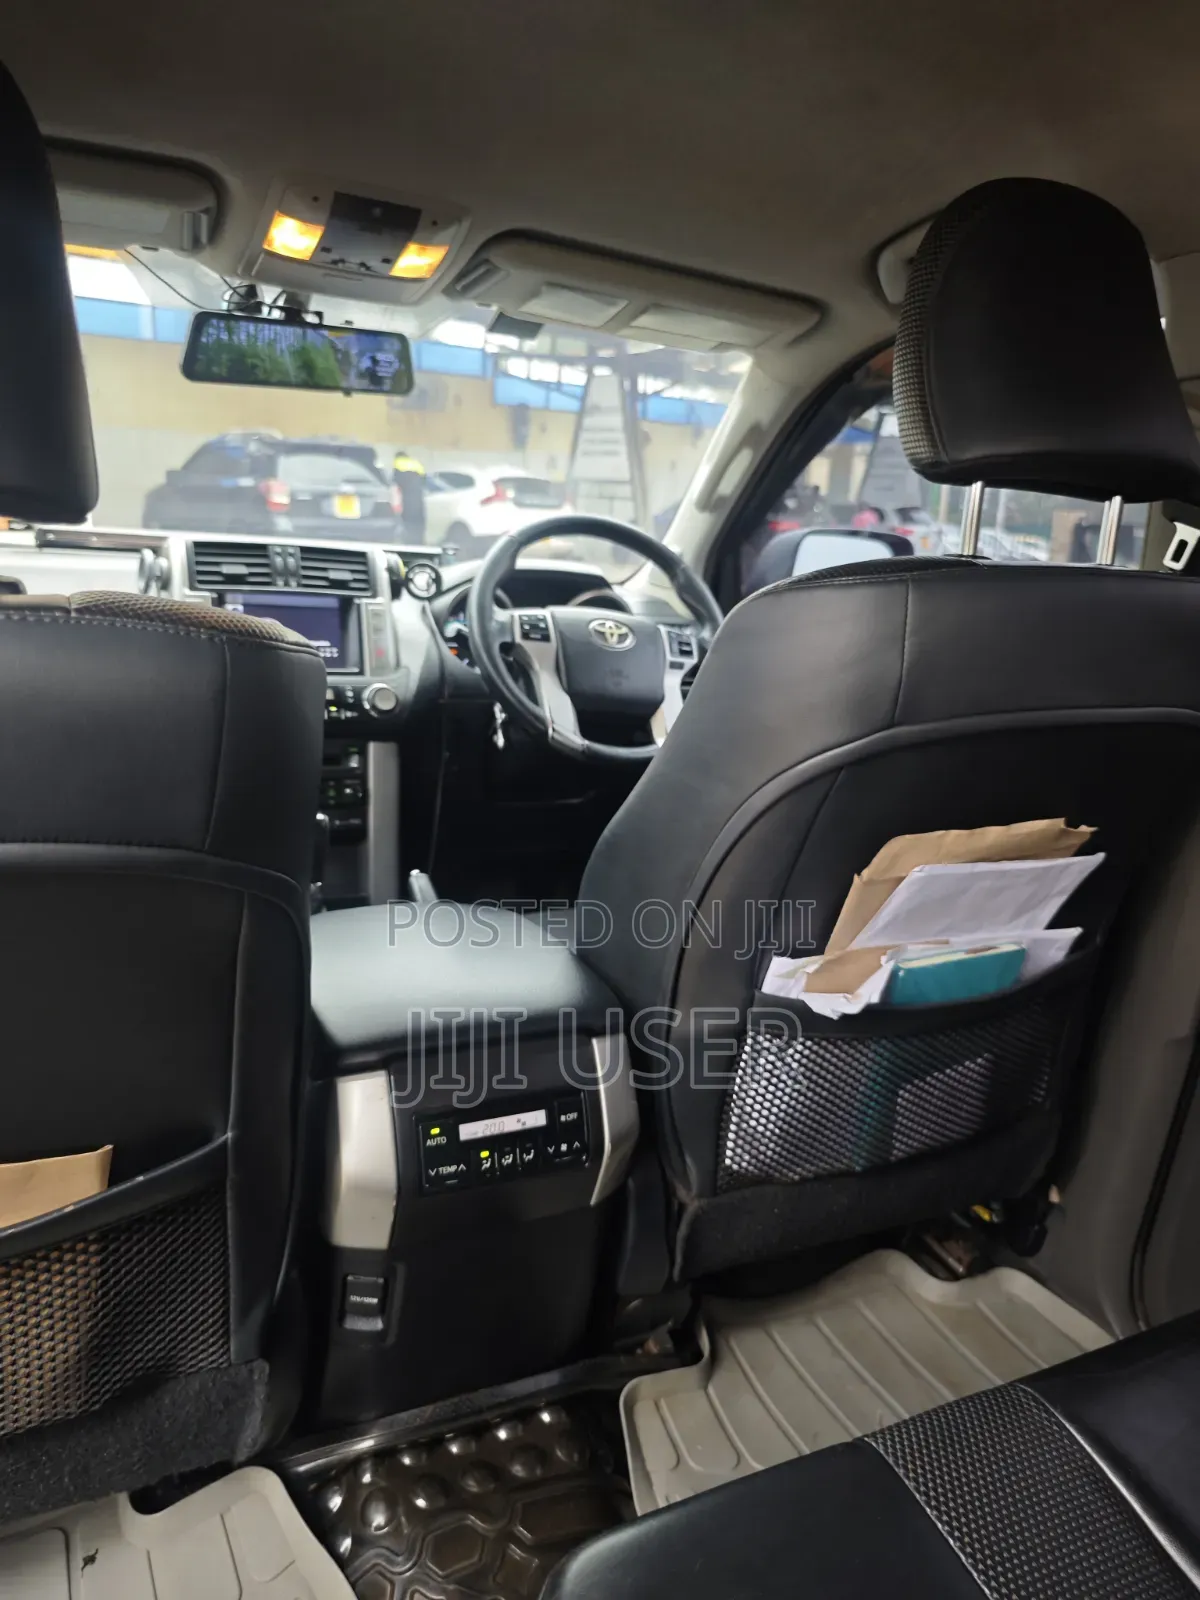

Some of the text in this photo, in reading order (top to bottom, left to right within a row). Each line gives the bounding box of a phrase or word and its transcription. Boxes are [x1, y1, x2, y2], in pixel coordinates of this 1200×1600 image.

[566, 1112, 578, 1121] OFF
[426, 1136, 447, 1146] AUTO
[438, 1165, 458, 1174] TEMP
